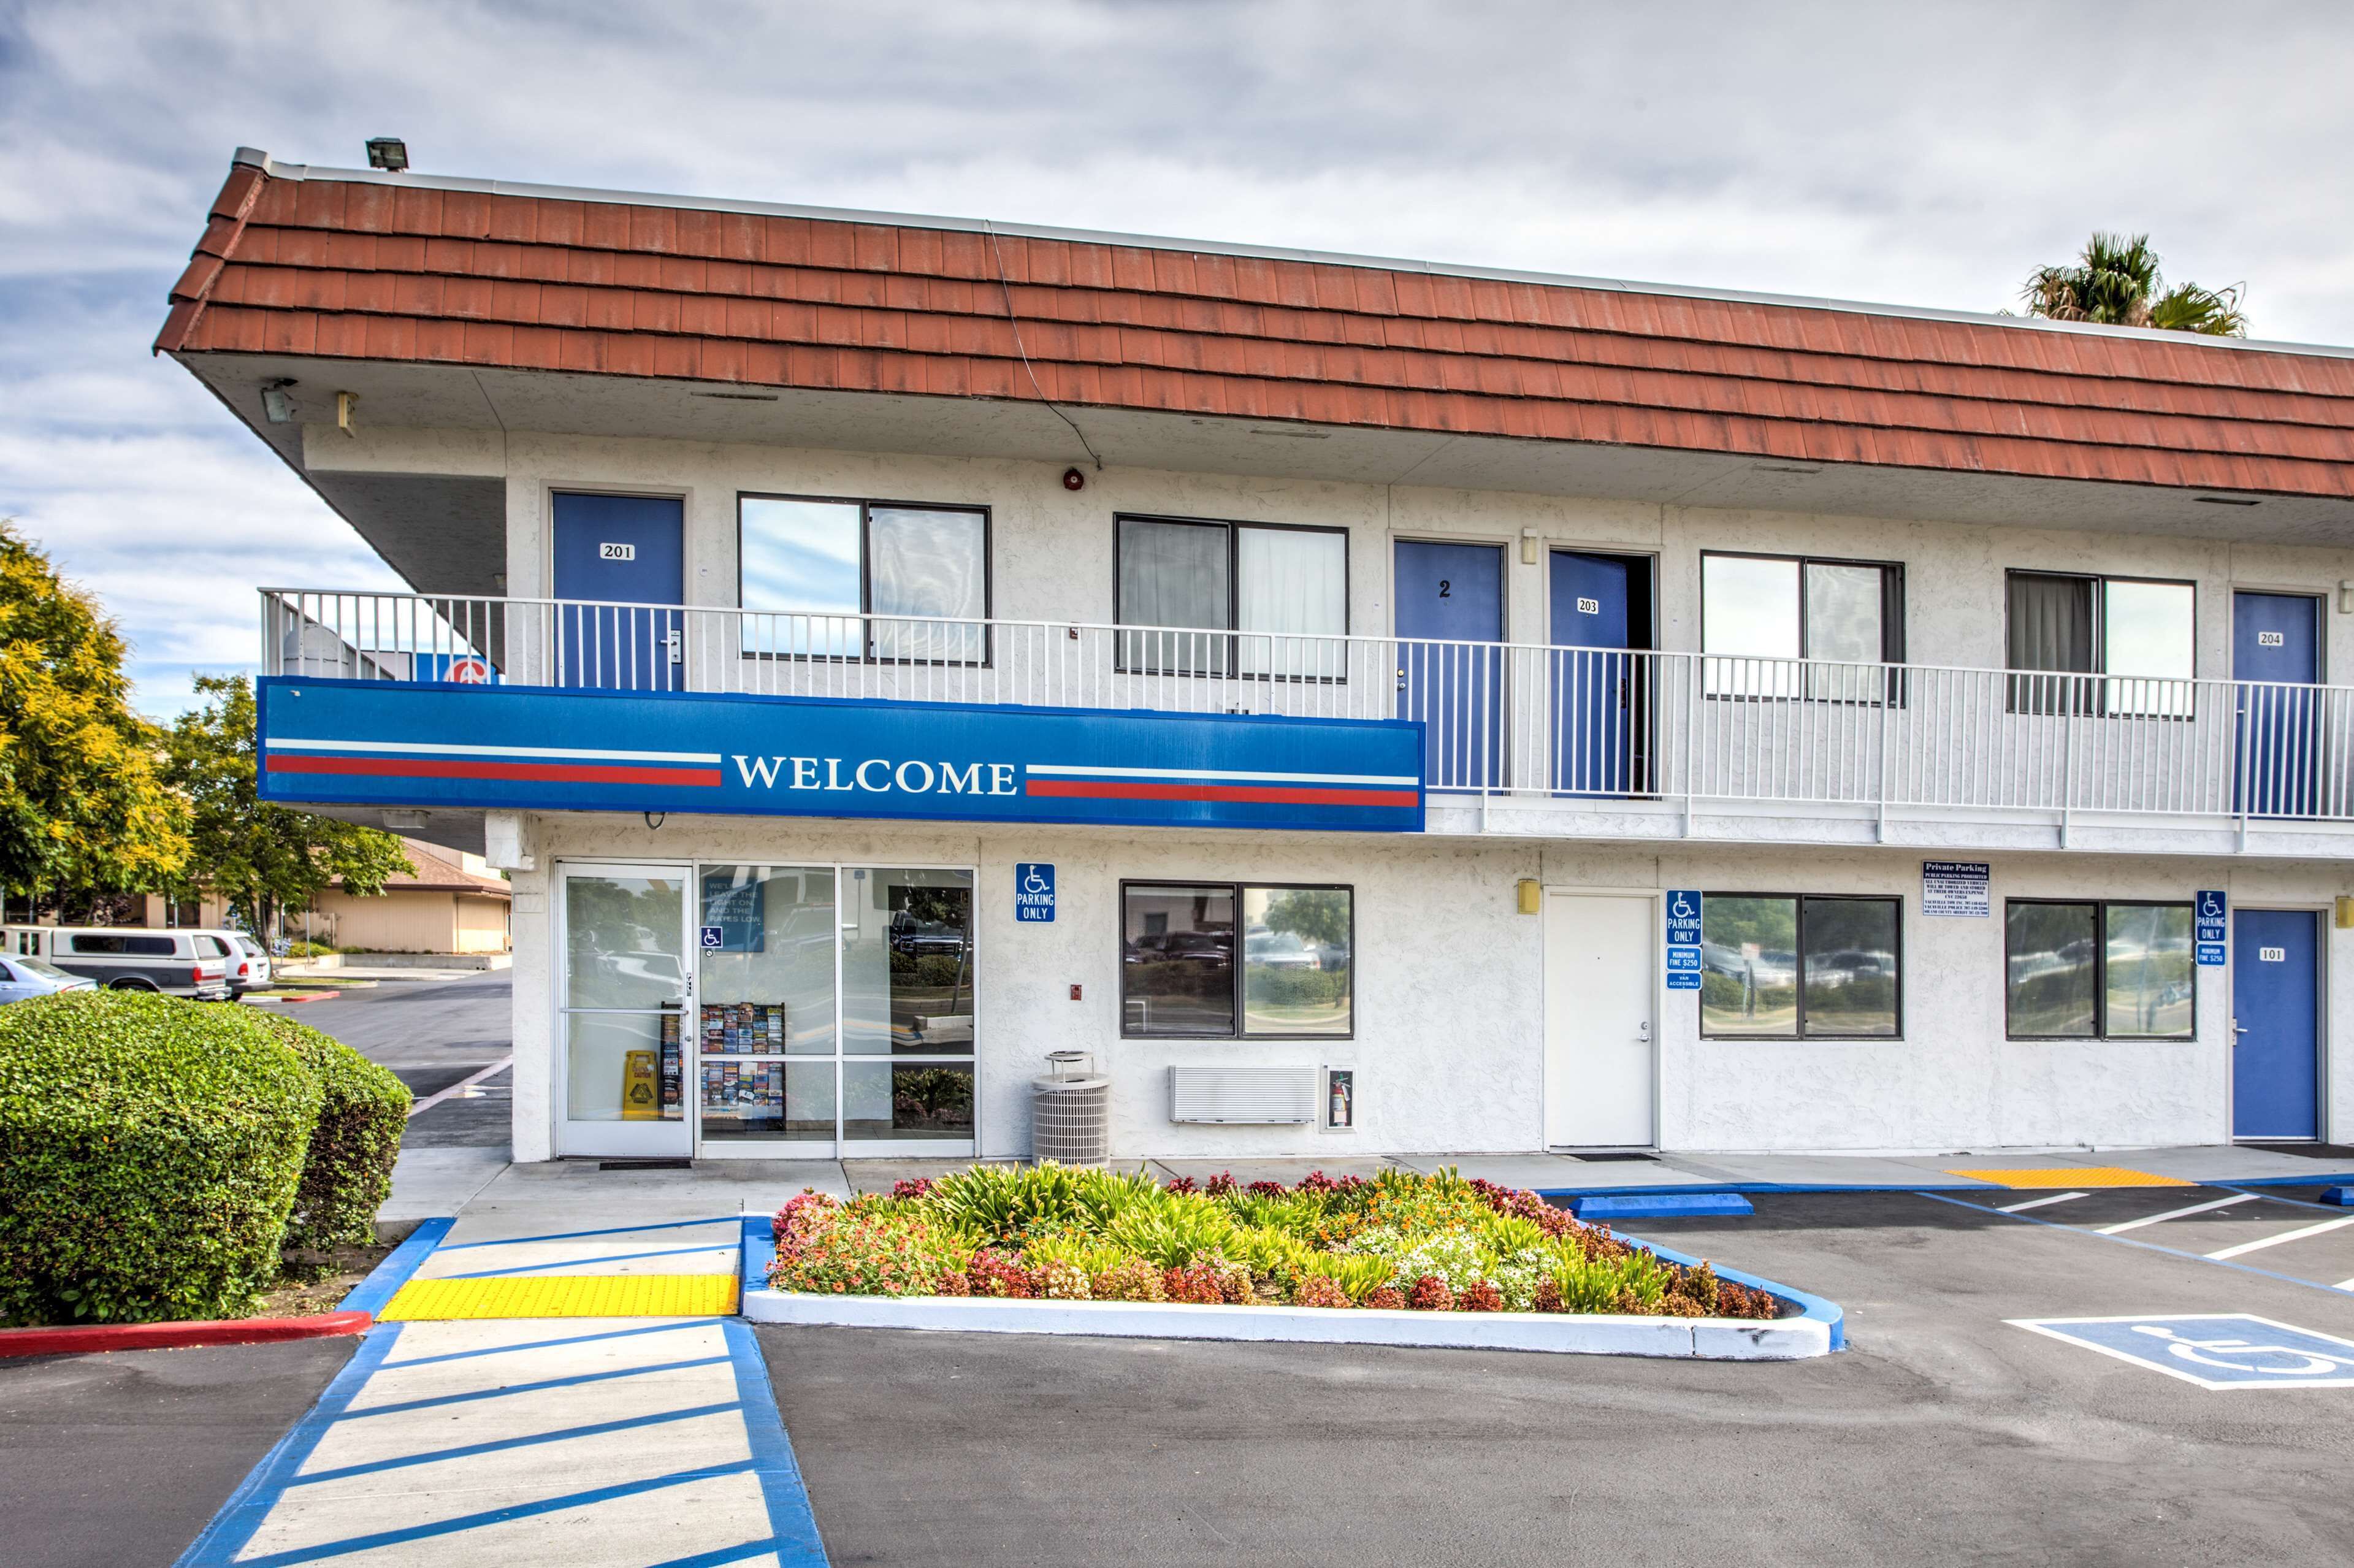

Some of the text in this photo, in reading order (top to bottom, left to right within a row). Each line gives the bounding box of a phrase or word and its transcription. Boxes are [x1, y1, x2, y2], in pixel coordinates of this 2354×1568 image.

[605, 545, 630, 558] 201
[1439, 579, 1451, 599] 2
[1580, 600, 1596, 612] 203
[2261, 633, 2280, 644] 204
[731, 755, 1018, 795] WELCOME
[1955, 864, 1987, 873] Parking
[1017, 893, 1054, 906] PARKING
[1023, 907, 1048, 919] ONLY
[1668, 918, 1700, 930] PARKING
[2198, 917, 2225, 927] PARKING
[1675, 931, 1694, 942] ONLY
[2202, 929, 2220, 939] ONLY
[2263, 949, 2280, 960] 101
[1683, 958, 1698, 967] $250
